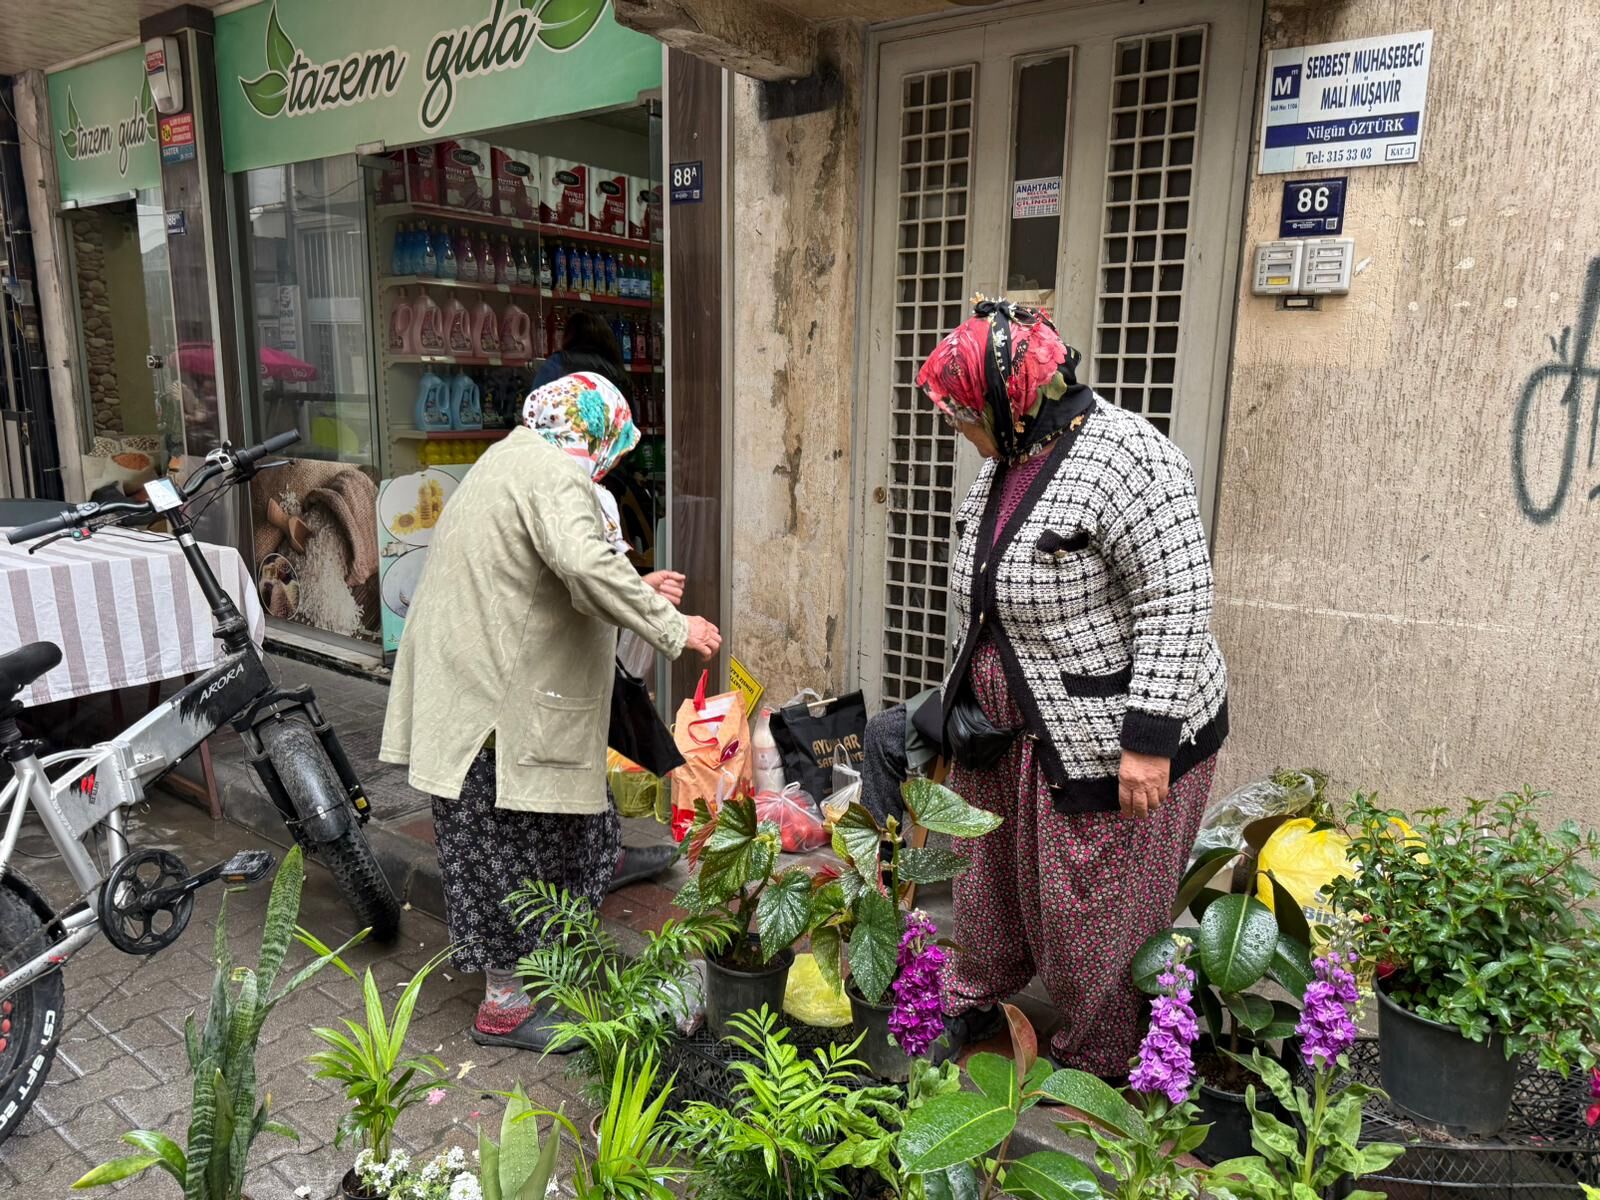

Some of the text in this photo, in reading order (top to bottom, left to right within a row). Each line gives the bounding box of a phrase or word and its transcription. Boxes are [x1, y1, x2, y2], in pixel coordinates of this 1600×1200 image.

[1306, 52, 1350, 80] SERBEST
[288, 50, 406, 113] tazem
[1320, 72, 1402, 112] MALİ MÜŞAVİR
[77, 125, 113, 157] tazem
[1306, 118, 1405, 141] Nilgün ÖZTÜRK
[1306, 147, 1373, 165] Tel: 315 33 03
[1297, 186, 1330, 213] 86
[199, 662, 244, 705] ARORA
